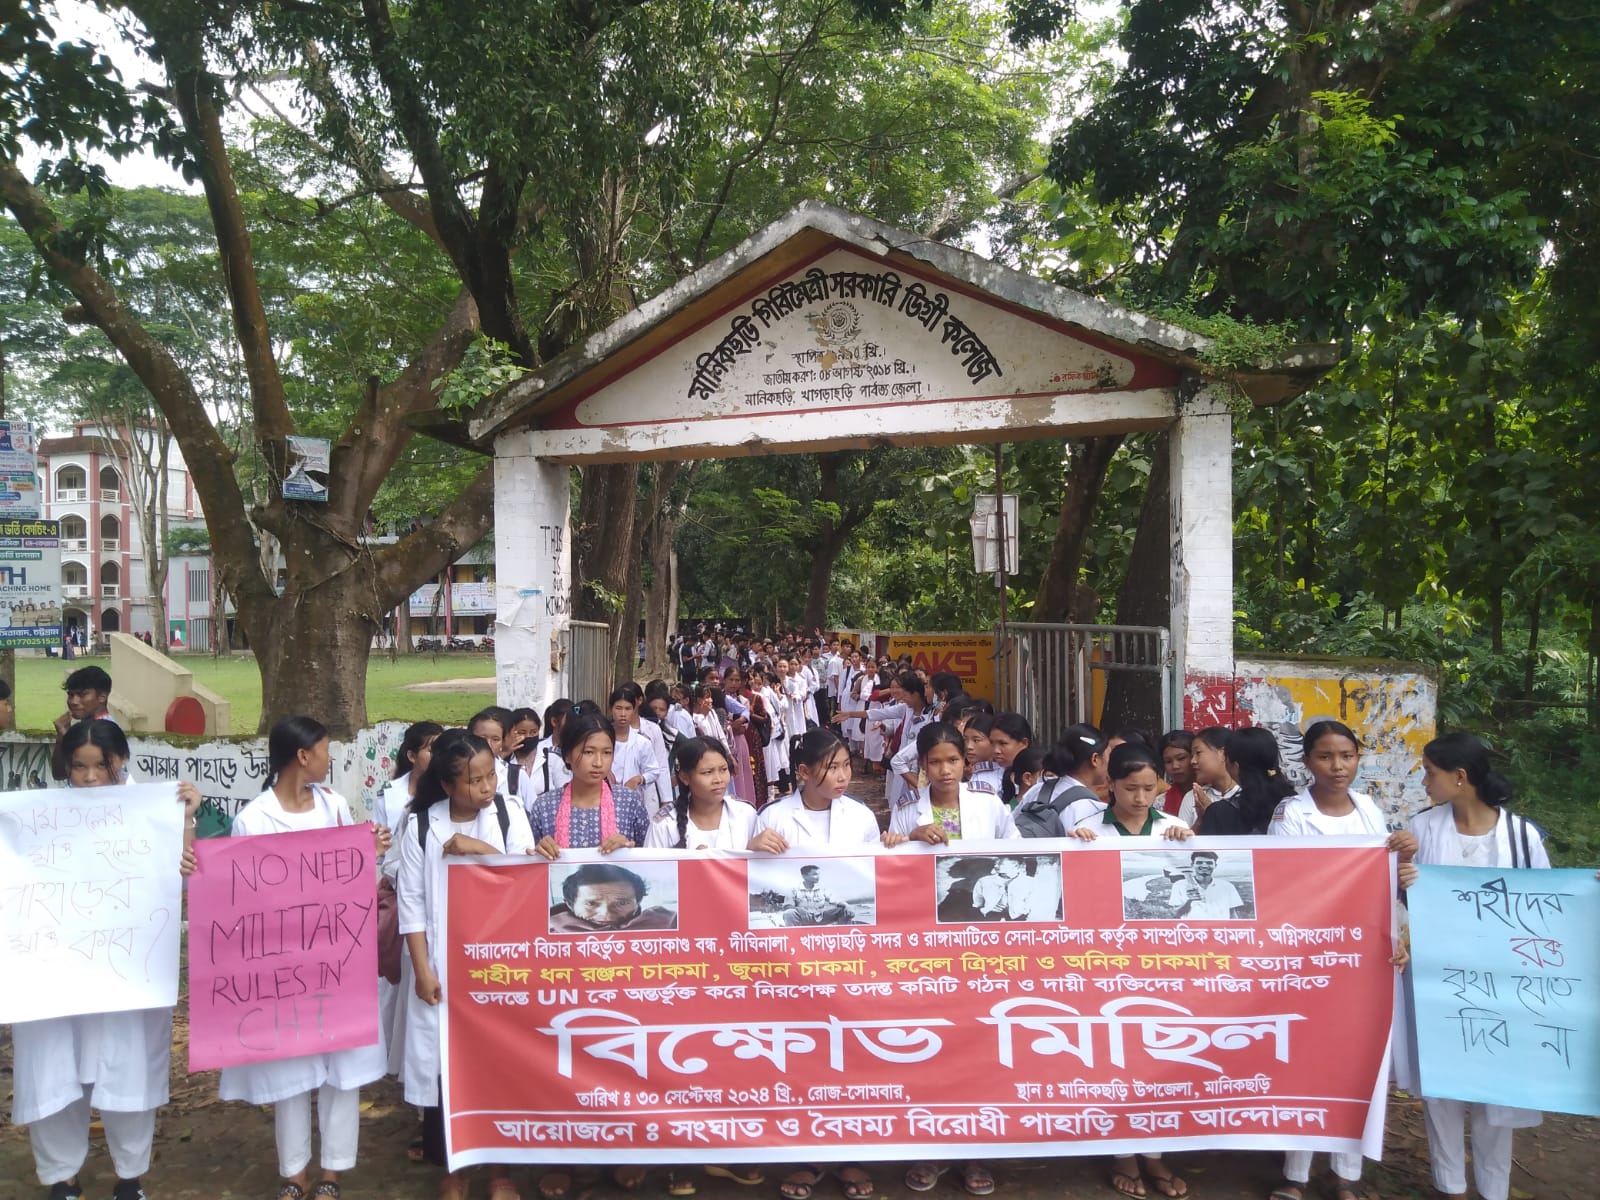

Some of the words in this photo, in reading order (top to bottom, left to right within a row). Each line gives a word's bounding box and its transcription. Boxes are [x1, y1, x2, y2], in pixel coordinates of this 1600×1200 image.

[688, 315, 762, 400] মানিকছড়ি
[829, 271, 902, 308] সরকারি
[941, 315, 1003, 385] কলেজ
[912, 651, 977, 677] AKS
[136, 753, 179, 780] আমার
[184, 756, 238, 789] পাহাড়ে
[231, 853, 289, 907] NO
[300, 847, 364, 893] NEED
[1451, 877, 1577, 938] শহীদের
[210, 898, 374, 967] MILITARY
[464, 940, 530, 961] সারাদেশে
[535, 936, 572, 958] বিচার
[630, 936, 690, 957] হত্যাকাণ্ড
[800, 928, 866, 953] খাগড়াছড়ি
[871, 932, 902, 950] সদর
[906, 933, 919, 949] ও
[923, 925, 1000, 948] রাঙ্গামাটিতে
[1099, 922, 1138, 951] কর্তৃক
[1143, 922, 1209, 947] সাম্প্রতিক
[1267, 922, 1346, 947] অগ্নিসংযোগ
[1350, 925, 1363, 942] ও
[212, 964, 307, 1007] RULES
[314, 959, 344, 990] IN
[469, 963, 531, 986] শহীদ
[540, 966, 573, 985] ধন
[580, 964, 634, 984] রঞ্জন
[727, 961, 792, 981] জুনান
[884, 956, 954, 975] রুবেল
[960, 951, 1028, 976] ত্রিপুরা
[1035, 956, 1056, 970] ও
[1062, 950, 1132, 971] অনিক
[1237, 955, 1303, 972] হত্যার
[1309, 950, 1363, 969] ঘটনা
[469, 990, 530, 1006] তদন্তে
[537, 988, 579, 1005] UN
[585, 988, 619, 1004] কে
[703, 984, 749, 1001] করে
[753, 980, 838, 1000] নিরপেক্ষ
[842, 982, 893, 998] তদন্ত
[897, 975, 961, 996] কমিটি
[967, 974, 1010, 994] গঠন
[1017, 978, 1035, 993] ও
[1040, 974, 1088, 994] দায়ী
[1092, 973, 1185, 993] ব্যক্তিদের
[1192, 974, 1253, 994] শাস্তির
[1257, 972, 1332, 992] দাবিতে
[535, 1007, 956, 1080] বিক্ষোভ
[975, 996, 1308, 1074] মিছিল
[1444, 1007, 1512, 1056] দিব
[1533, 1022, 1579, 1071] না
[575, 1087, 620, 1108] তারিখ
[635, 1091, 660, 1106] ৩০
[664, 1083, 723, 1105] সেপ্টেম্বর
[727, 1087, 771, 1104] ২০২৪
[1014, 1081, 1042, 1102] স্থান
[1058, 1077, 1129, 1102] মানিকছড়ি
[1203, 1073, 1272, 1096] মানিকছড়ি
[494, 1118, 637, 1143] আয়োজনে
[668, 1116, 767, 1143] সংঘাত
[775, 1118, 801, 1138] ও
[810, 1108, 898, 1140] বৈষম্য
[904, 1107, 1010, 1138] বিরোধী
[1018, 1106, 1119, 1138] পাহাড়ি
[1126, 1109, 1184, 1133] ছাত্র
[1189, 1102, 1330, 1130] আন্দোলন
